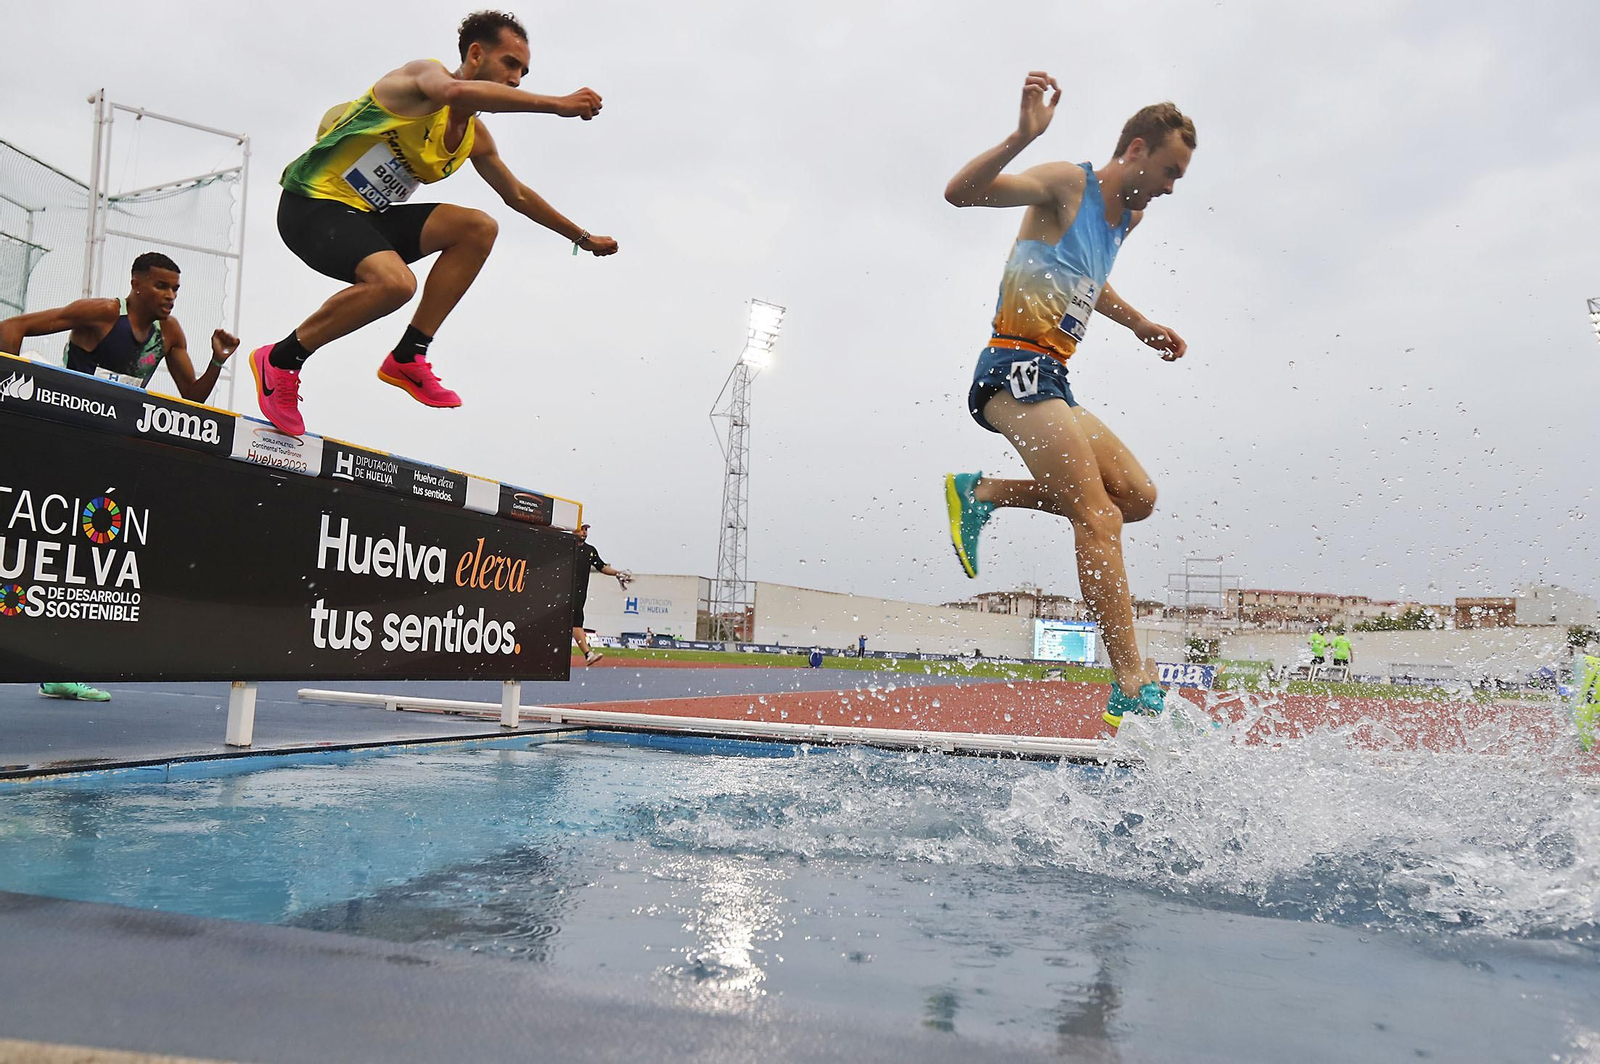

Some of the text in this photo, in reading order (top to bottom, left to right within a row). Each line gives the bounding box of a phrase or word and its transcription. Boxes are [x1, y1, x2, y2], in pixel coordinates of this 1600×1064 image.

[358, 183, 391, 212] Jom
[36, 387, 117, 420] IBERDROLA
[355, 455, 399, 475] DIPUTACIÓN
[354, 468, 394, 485] DE HUELVA
[413, 469, 454, 489] Huelva eleva
[412, 484, 453, 502] tus sentidos.
[316, 513, 528, 593] Huelva eleva
[47, 586, 141, 605] DE DESARROLLO
[45, 600, 140, 622] SOSTENIBLE
[647, 606, 669, 614] HUELVA
[310, 597, 522, 655] tus sentidos.
